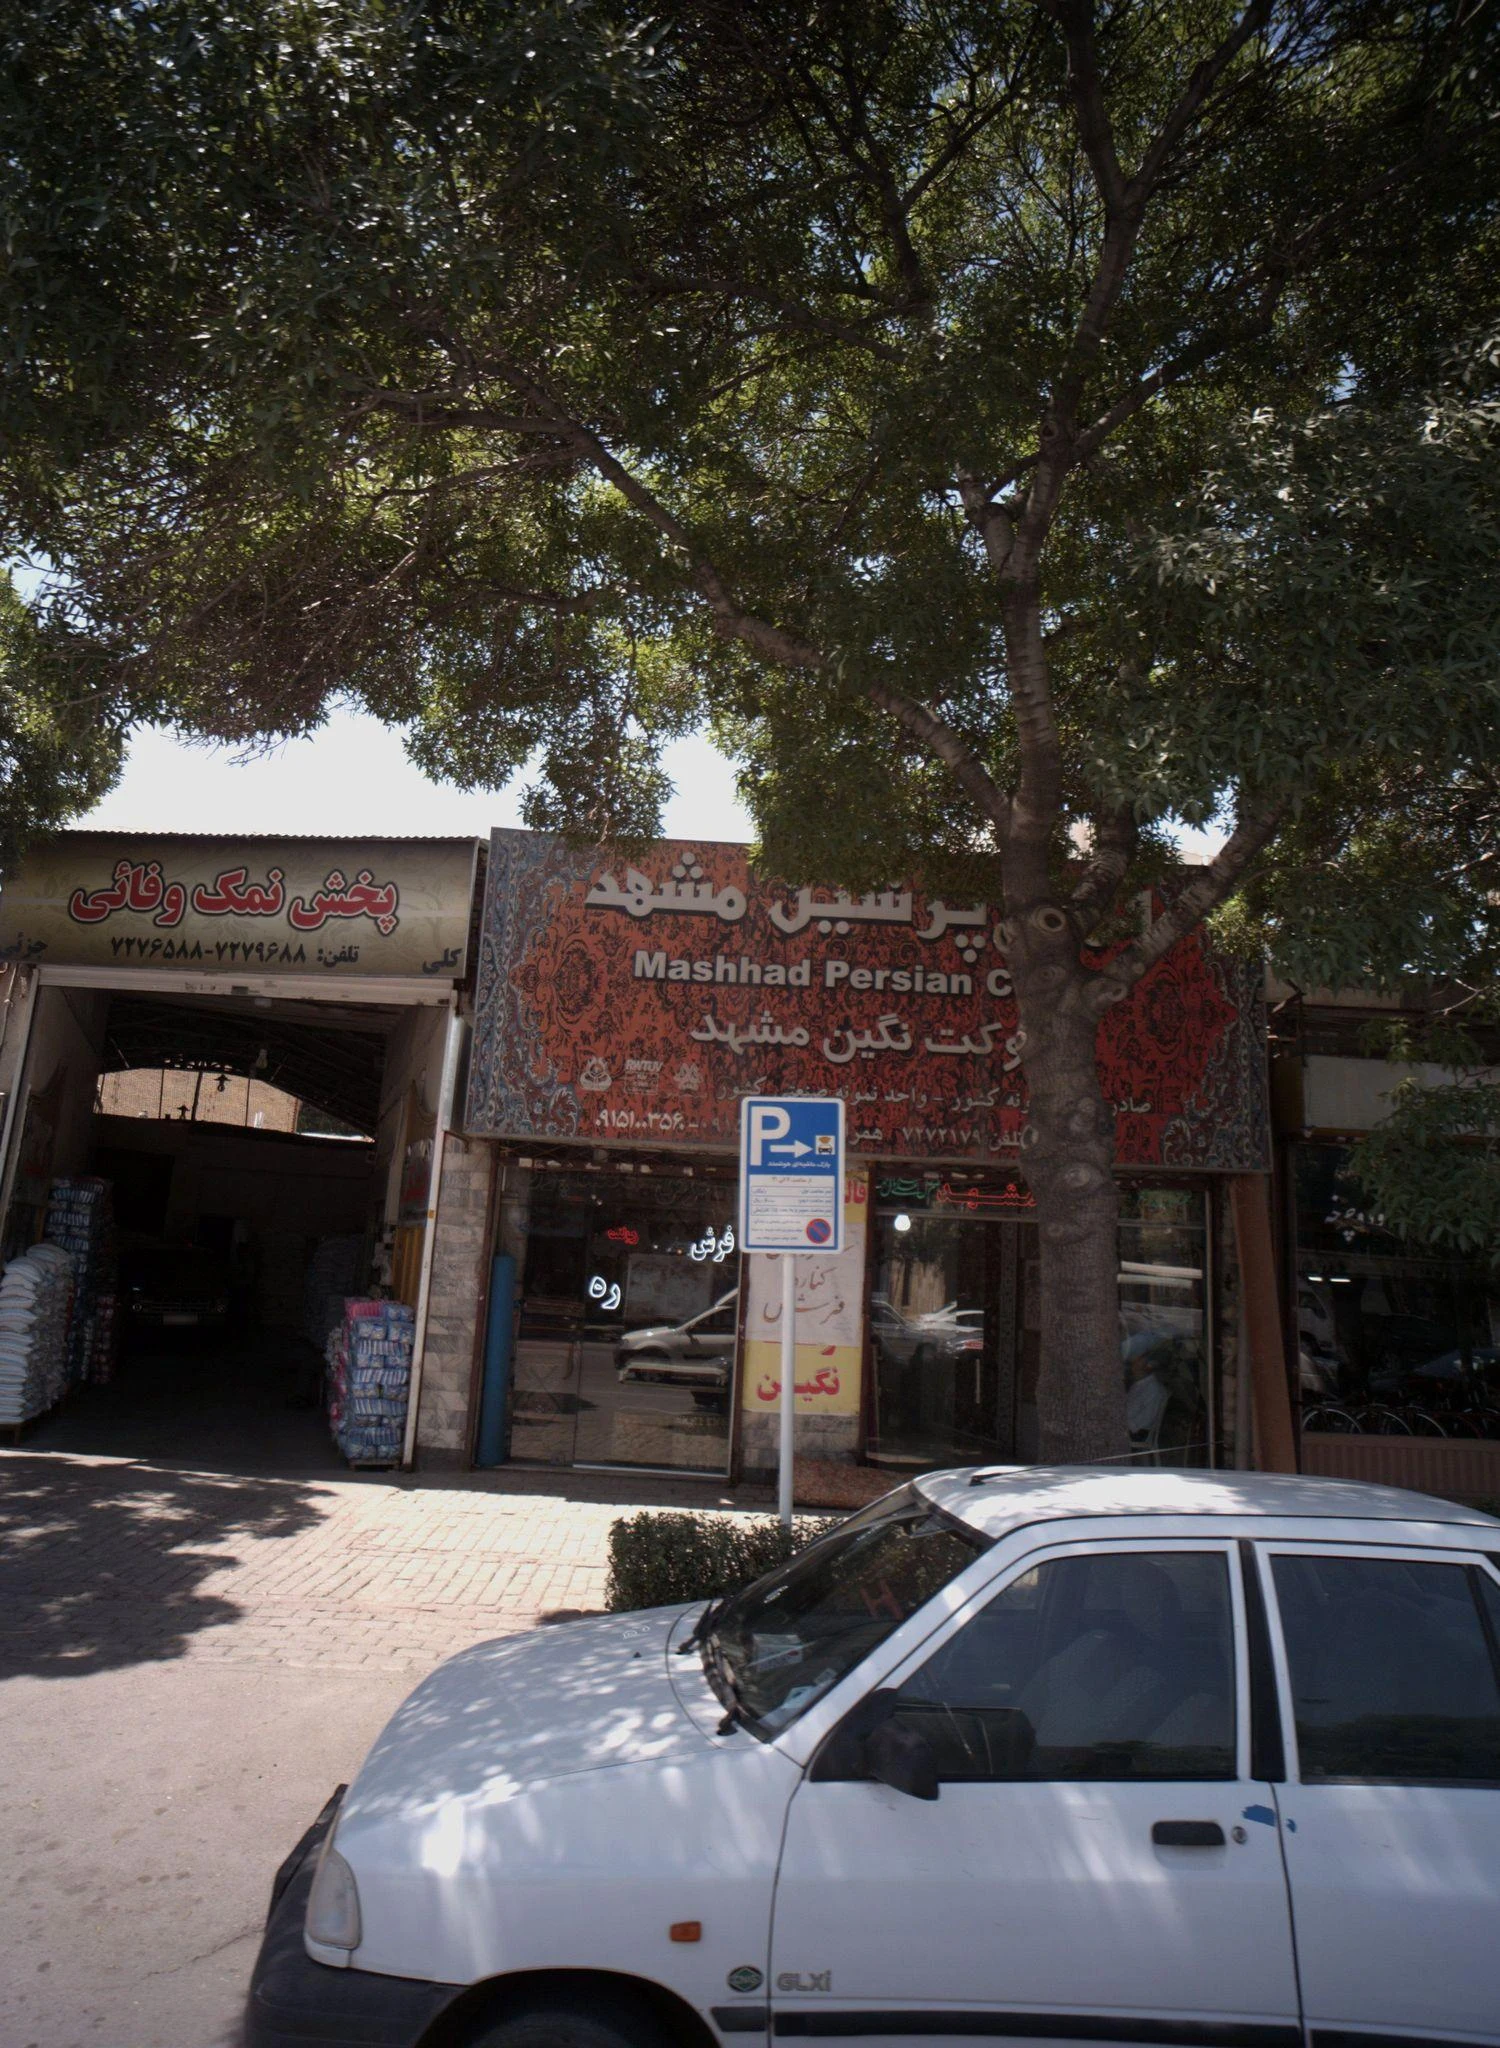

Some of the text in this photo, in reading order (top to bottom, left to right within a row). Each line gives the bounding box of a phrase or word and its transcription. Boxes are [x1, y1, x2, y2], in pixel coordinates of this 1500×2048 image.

[70, 861, 399, 935] پخش نمک وفائی
[584, 851, 748, 921] مشهد
[421, 948, 463, 974] کلی
[633, 950, 811, 988] Mashhad
[825, 959, 973, 995] Persian
[690, 1010, 1027, 1072] وکت نگین مشهد
[884, 1087, 928, 1109] واحد
[950, 1086, 1000, 1112] کشور
[749, 1105, 792, 1167] P
[690, 1224, 736, 1263] فرش
[777, 1969, 833, 1993] GLXi
